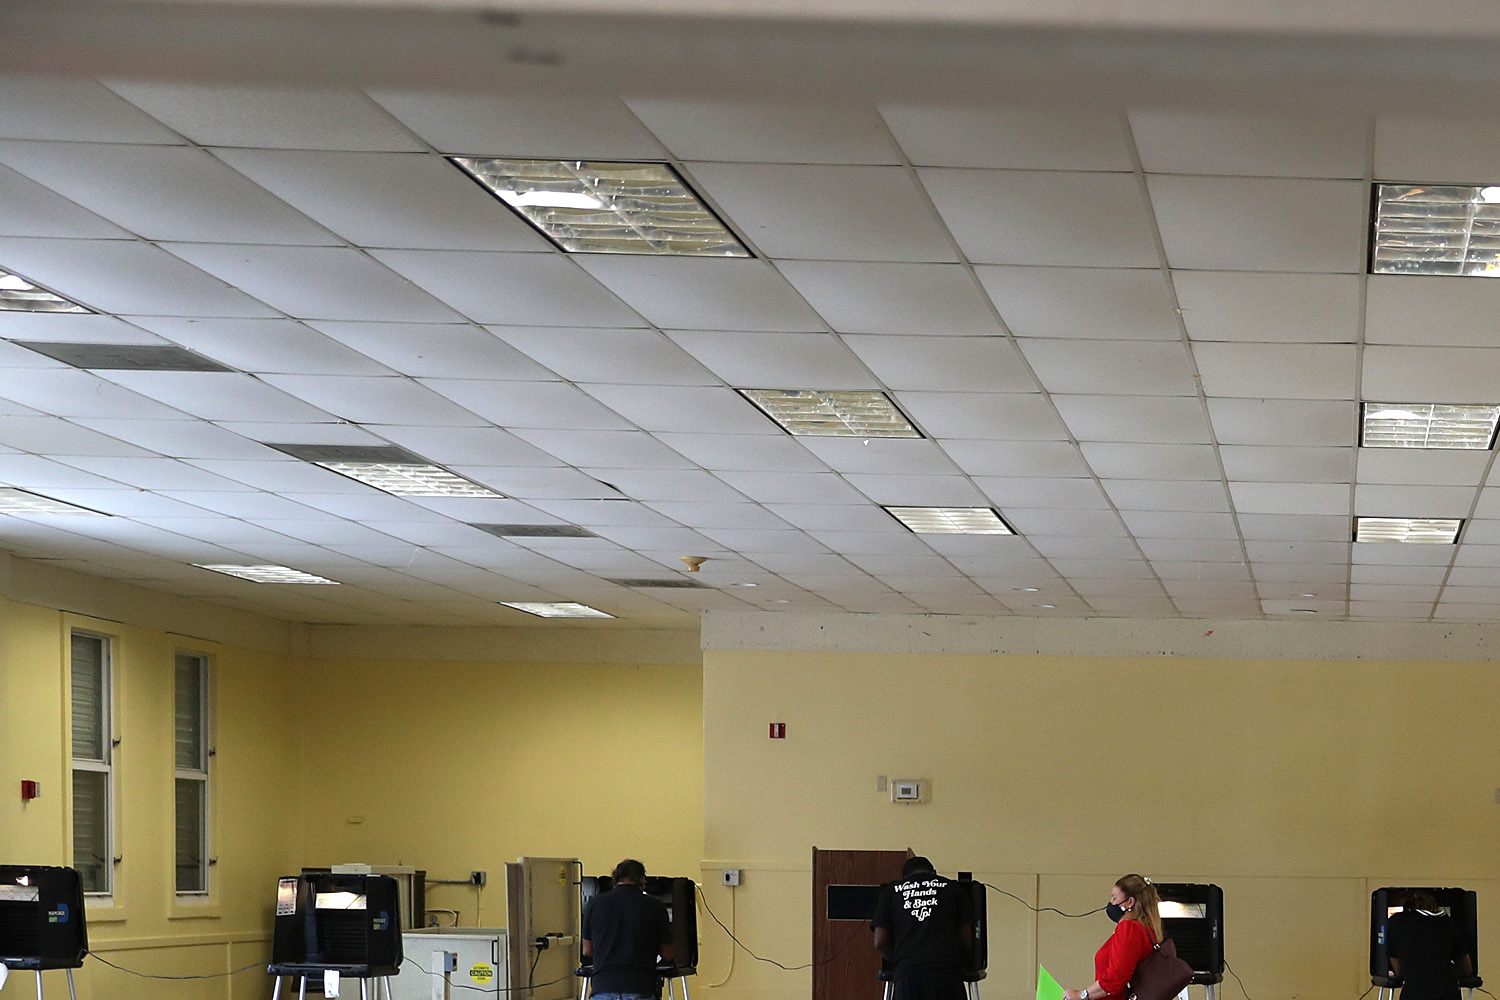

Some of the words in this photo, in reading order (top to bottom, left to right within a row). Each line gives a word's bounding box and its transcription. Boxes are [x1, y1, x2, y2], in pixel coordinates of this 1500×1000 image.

[894, 881, 920, 892] Wash
[922, 879, 947, 888] Your
[903, 888, 937, 900] Hands
[903, 901, 911, 909] &
[913, 898, 938, 908] Back
[911, 907, 932, 921] Up!
